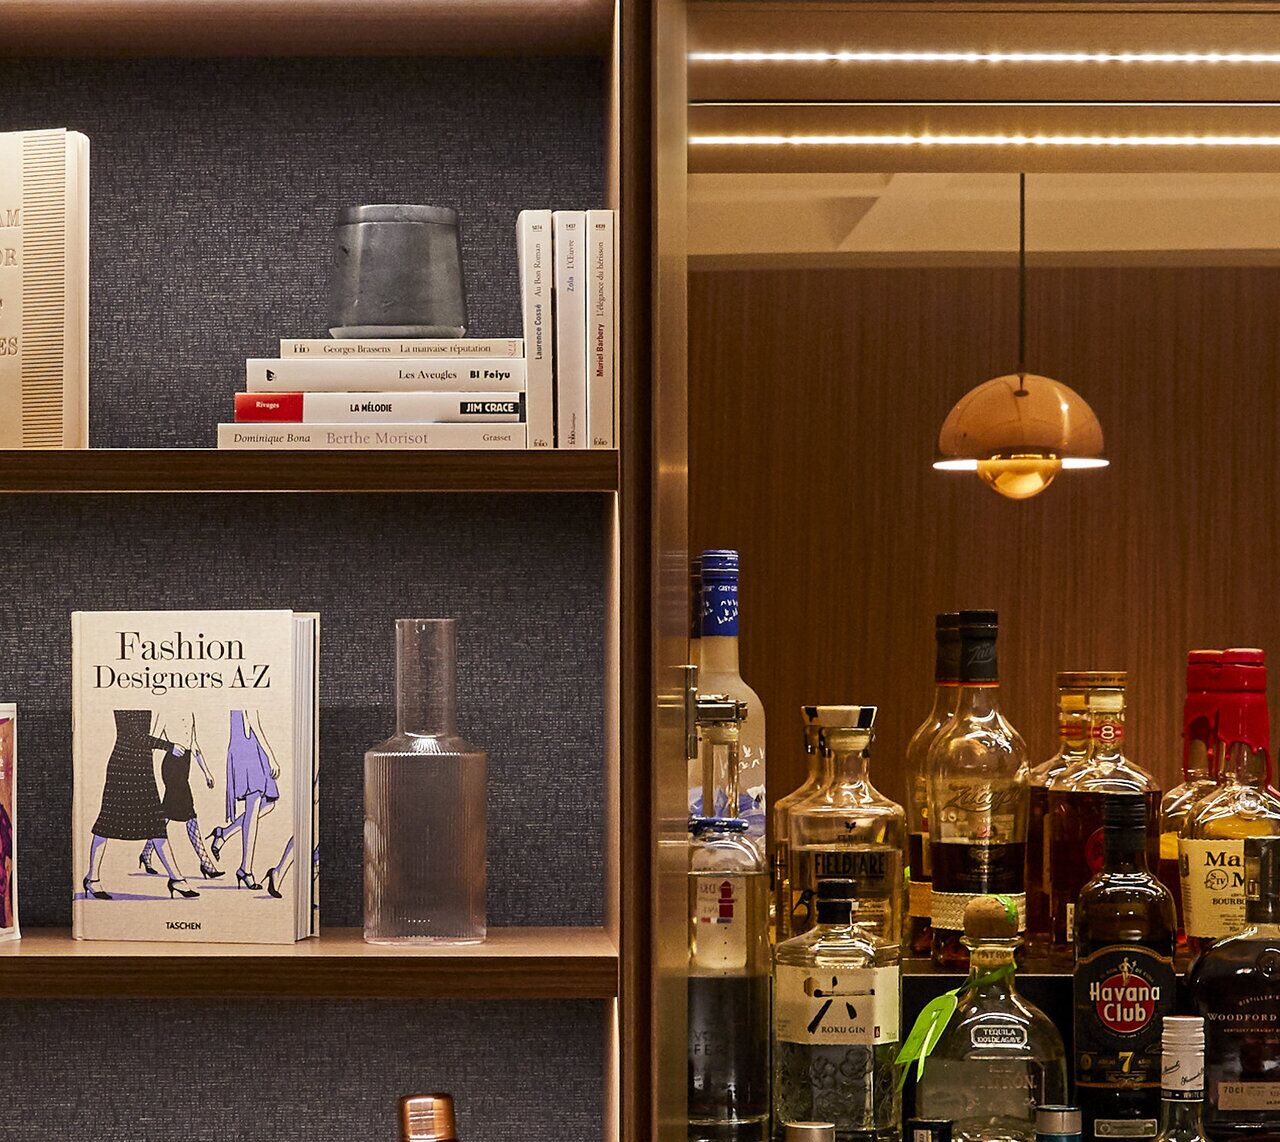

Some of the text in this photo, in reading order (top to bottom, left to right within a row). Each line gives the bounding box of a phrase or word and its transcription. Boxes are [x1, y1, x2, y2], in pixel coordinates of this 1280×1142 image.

[534, 243, 542, 297] Au Bon Roman
[596, 271, 604, 281] du
[567, 276, 575, 292] Zola
[400, 343, 491, 355] La mauvaise réputation
[535, 327, 543, 360] Laurence
[323, 344, 391, 356] Georges Brassens
[596, 323, 606, 377] Muriel Barbery
[399, 369, 457, 381] Les Aveugles
[469, 370, 511, 381] BI Feiyu
[256, 400, 280, 411] Rivages
[350, 401, 393, 412] LA MÉLODIE
[465, 402, 514, 412] JIM CRACE
[233, 433, 311, 444] Dominique Bona
[326, 432, 428, 445] Berthe Morisot
[482, 433, 511, 442] Grasset
[115, 630, 246, 661] Fashion
[92, 663, 272, 695] Designers A-Z
[1101, 725, 1115, 740] 8
[165, 921, 202, 930] TASCHEN
[1089, 981, 1161, 1002] Havana
[1103, 1003, 1147, 1022] Club
[1207, 1012, 1278, 1021] WOODFORD
[821, 1026, 866, 1034] ROKU GIN
[982, 1028, 1017, 1036] TEQUILA
[1118, 1051, 1134, 1074] 7
